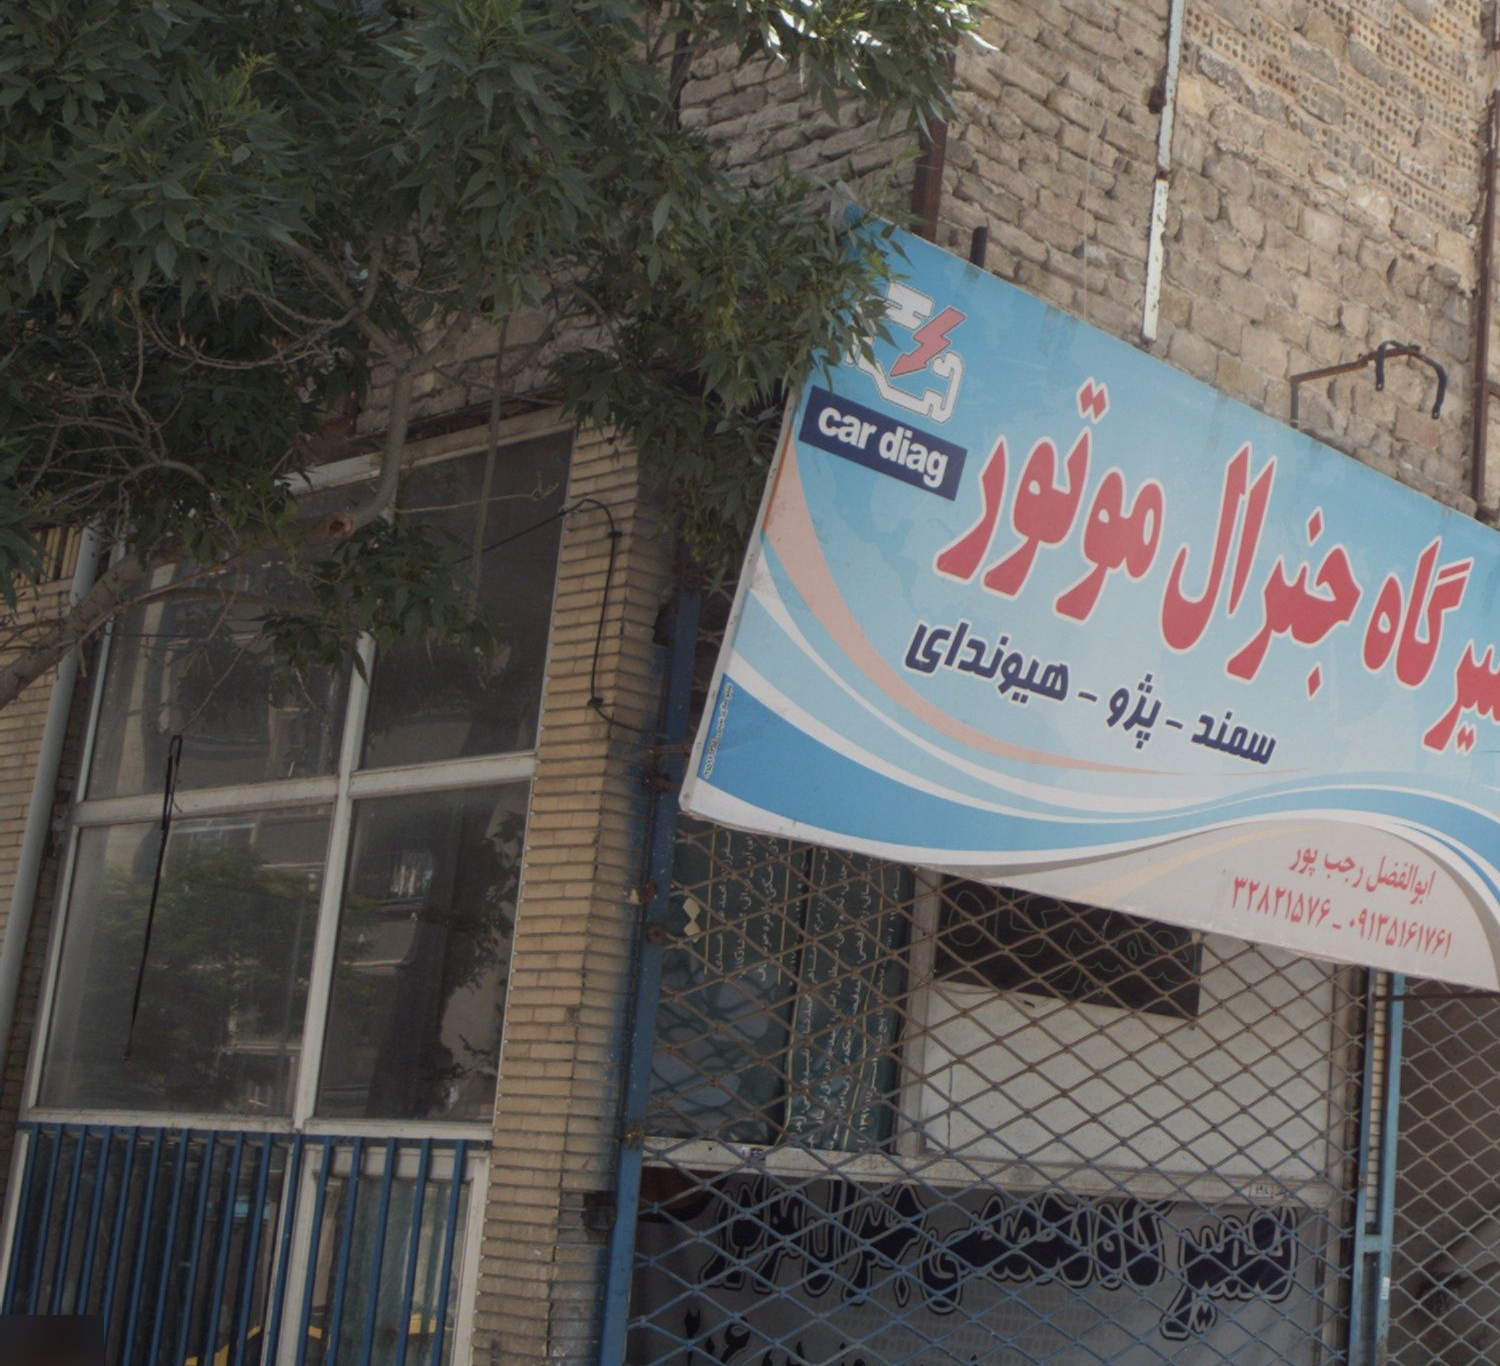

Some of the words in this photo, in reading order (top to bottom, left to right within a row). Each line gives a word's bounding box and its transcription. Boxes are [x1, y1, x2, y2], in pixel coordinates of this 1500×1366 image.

[818, 407, 877, 450] car
[879, 426, 949, 488] diag
[936, 381, 1162, 622] موتور
[1160, 442, 1361, 698] جنرال
[904, 621, 1070, 704] هیوندای
[1106, 673, 1162, 750] پژو
[1190, 711, 1278, 765] سمند
[1289, 846, 1319, 877] پور
[1324, 852, 1364, 888] رجب
[1366, 855, 1437, 905] ابوالفضل
[1231, 875, 1332, 927] ۳۲۸۲۱۵۷۶
[1349, 907, 1453, 959] ۰۹۱۳۵۱۶۱۷۶۱
